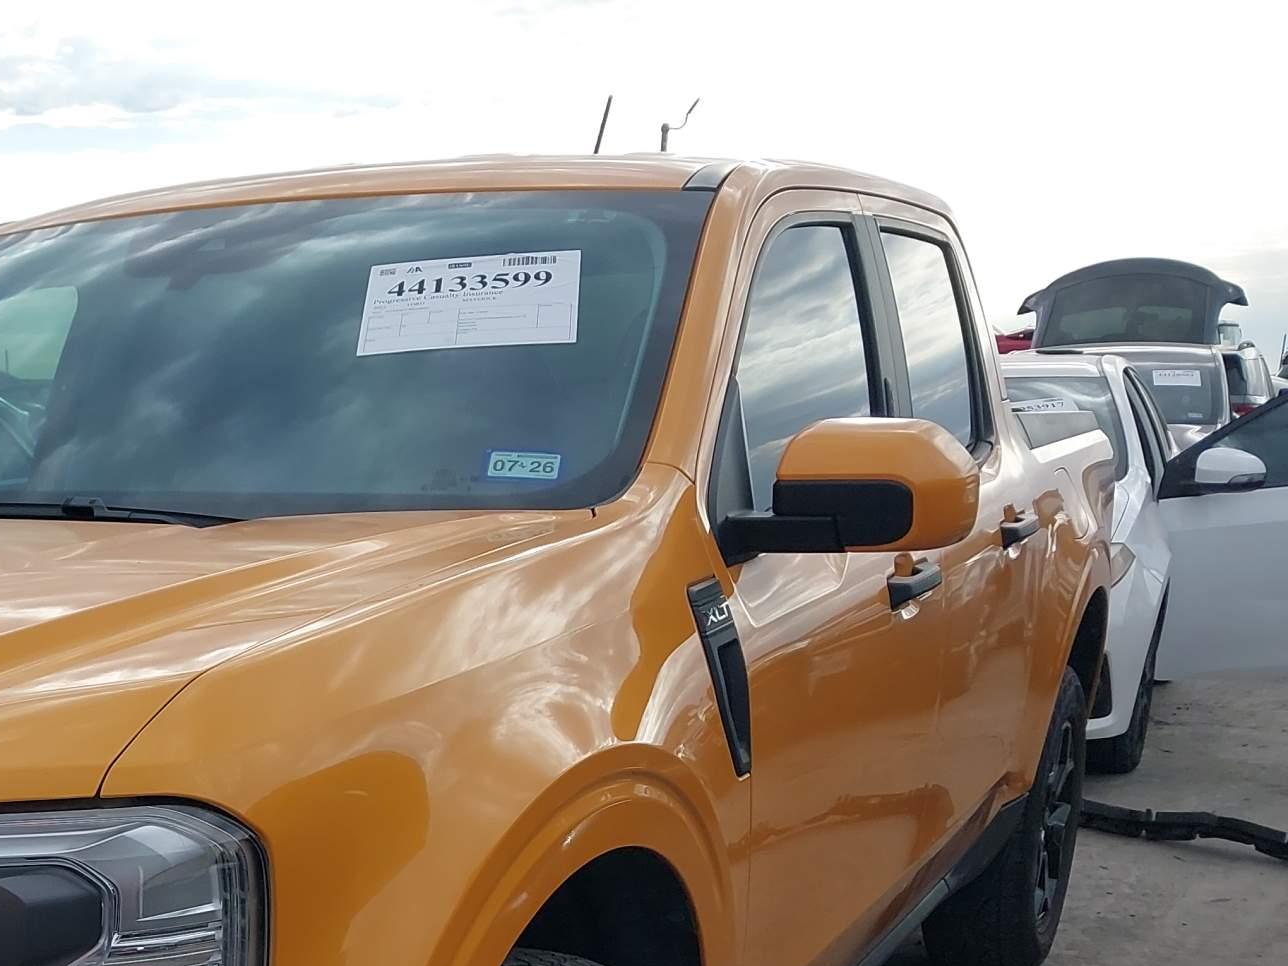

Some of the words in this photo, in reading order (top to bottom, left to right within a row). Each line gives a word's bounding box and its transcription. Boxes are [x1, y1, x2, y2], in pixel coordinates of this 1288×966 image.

[387, 270, 553, 297] 44133599
[462, 289, 504, 297] Insurance
[706, 600, 729, 626] XLT
